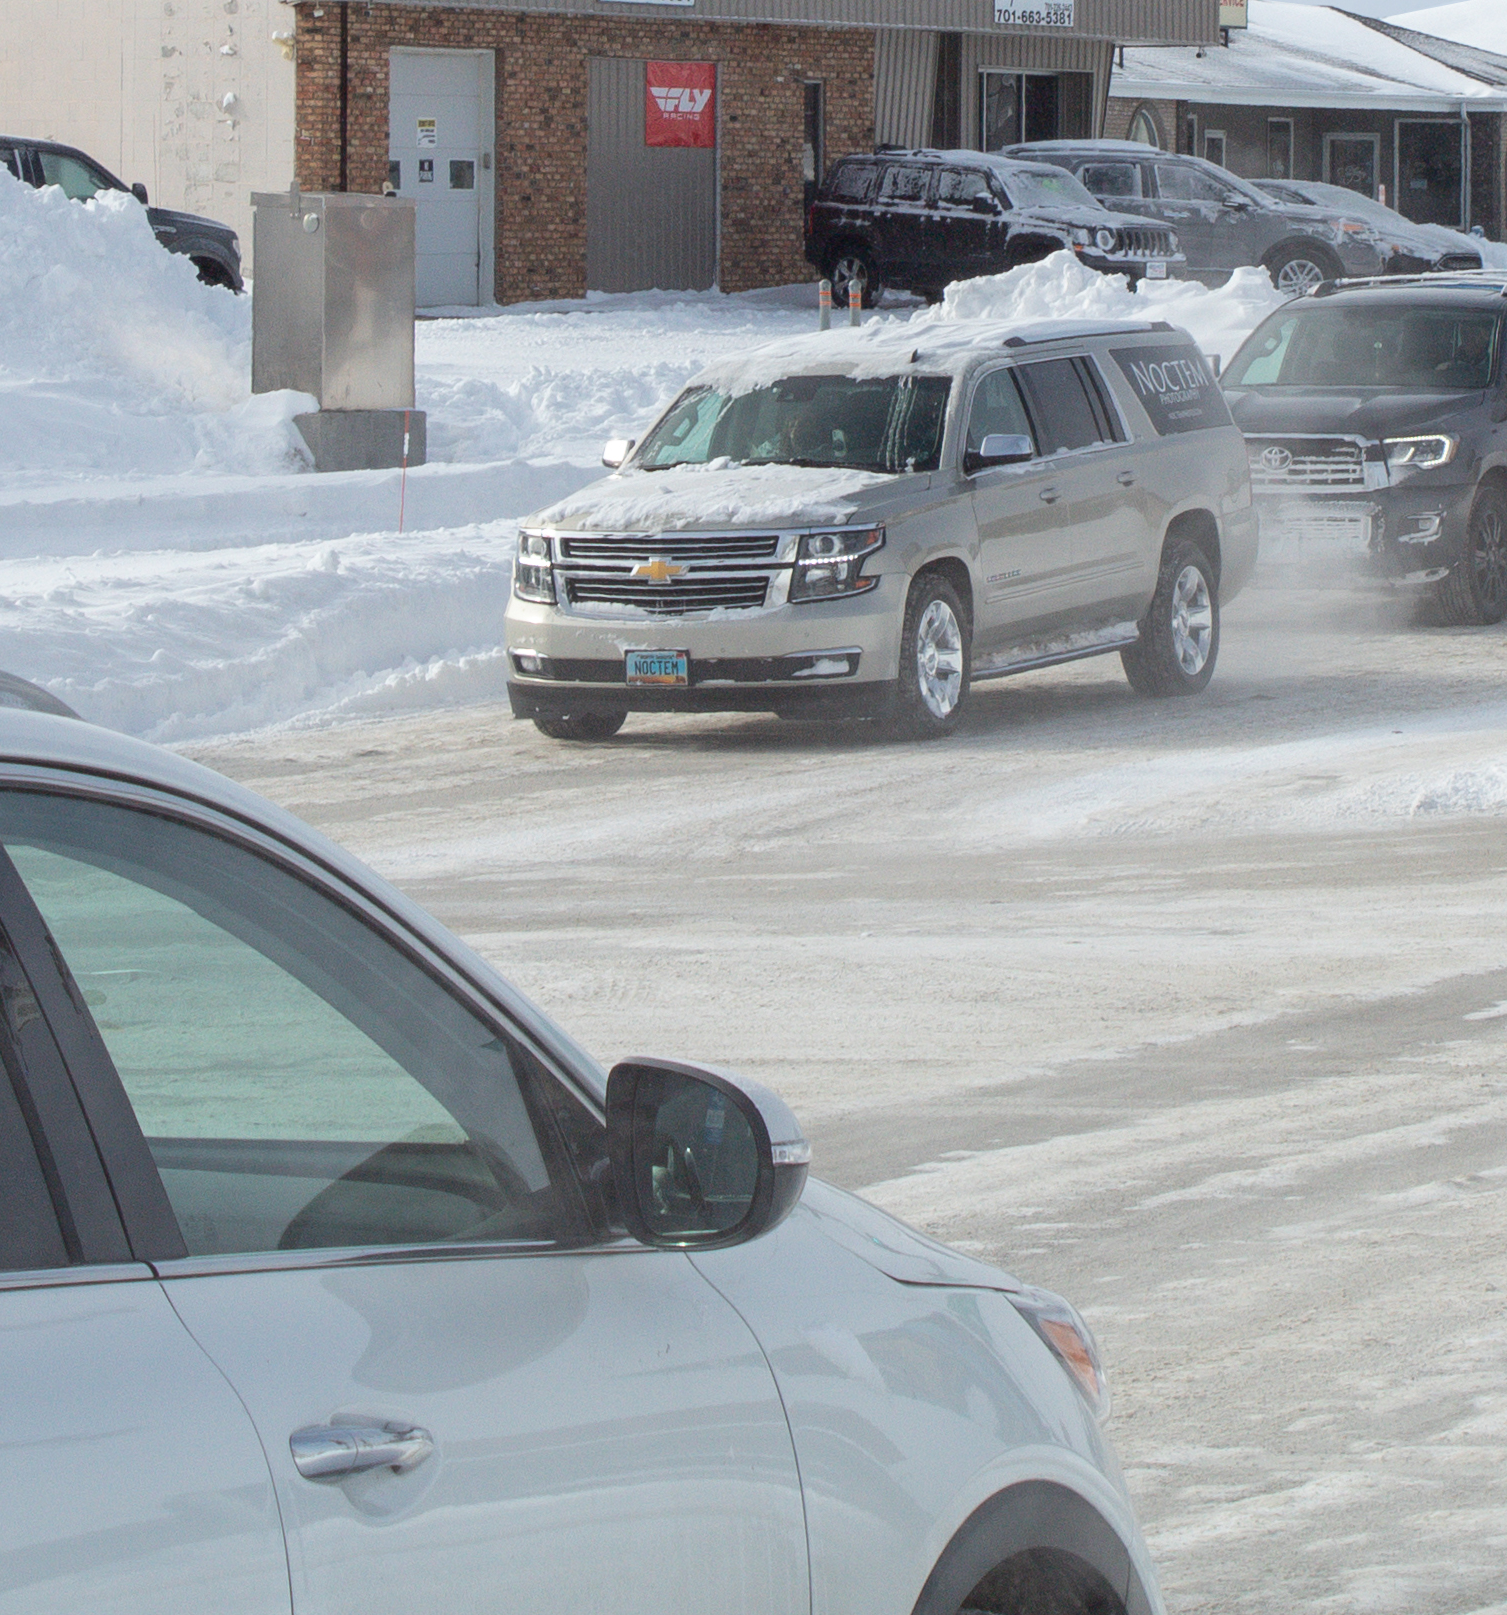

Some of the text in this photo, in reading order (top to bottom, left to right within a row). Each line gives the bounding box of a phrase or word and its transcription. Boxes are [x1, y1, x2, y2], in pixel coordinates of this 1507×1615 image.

[997, 9, 1071, 25] 701-663-5381
[649, 87, 712, 112] FLY
[1130, 360, 1209, 395] NOCTEM
[634, 660, 679, 675] NOCTEM
